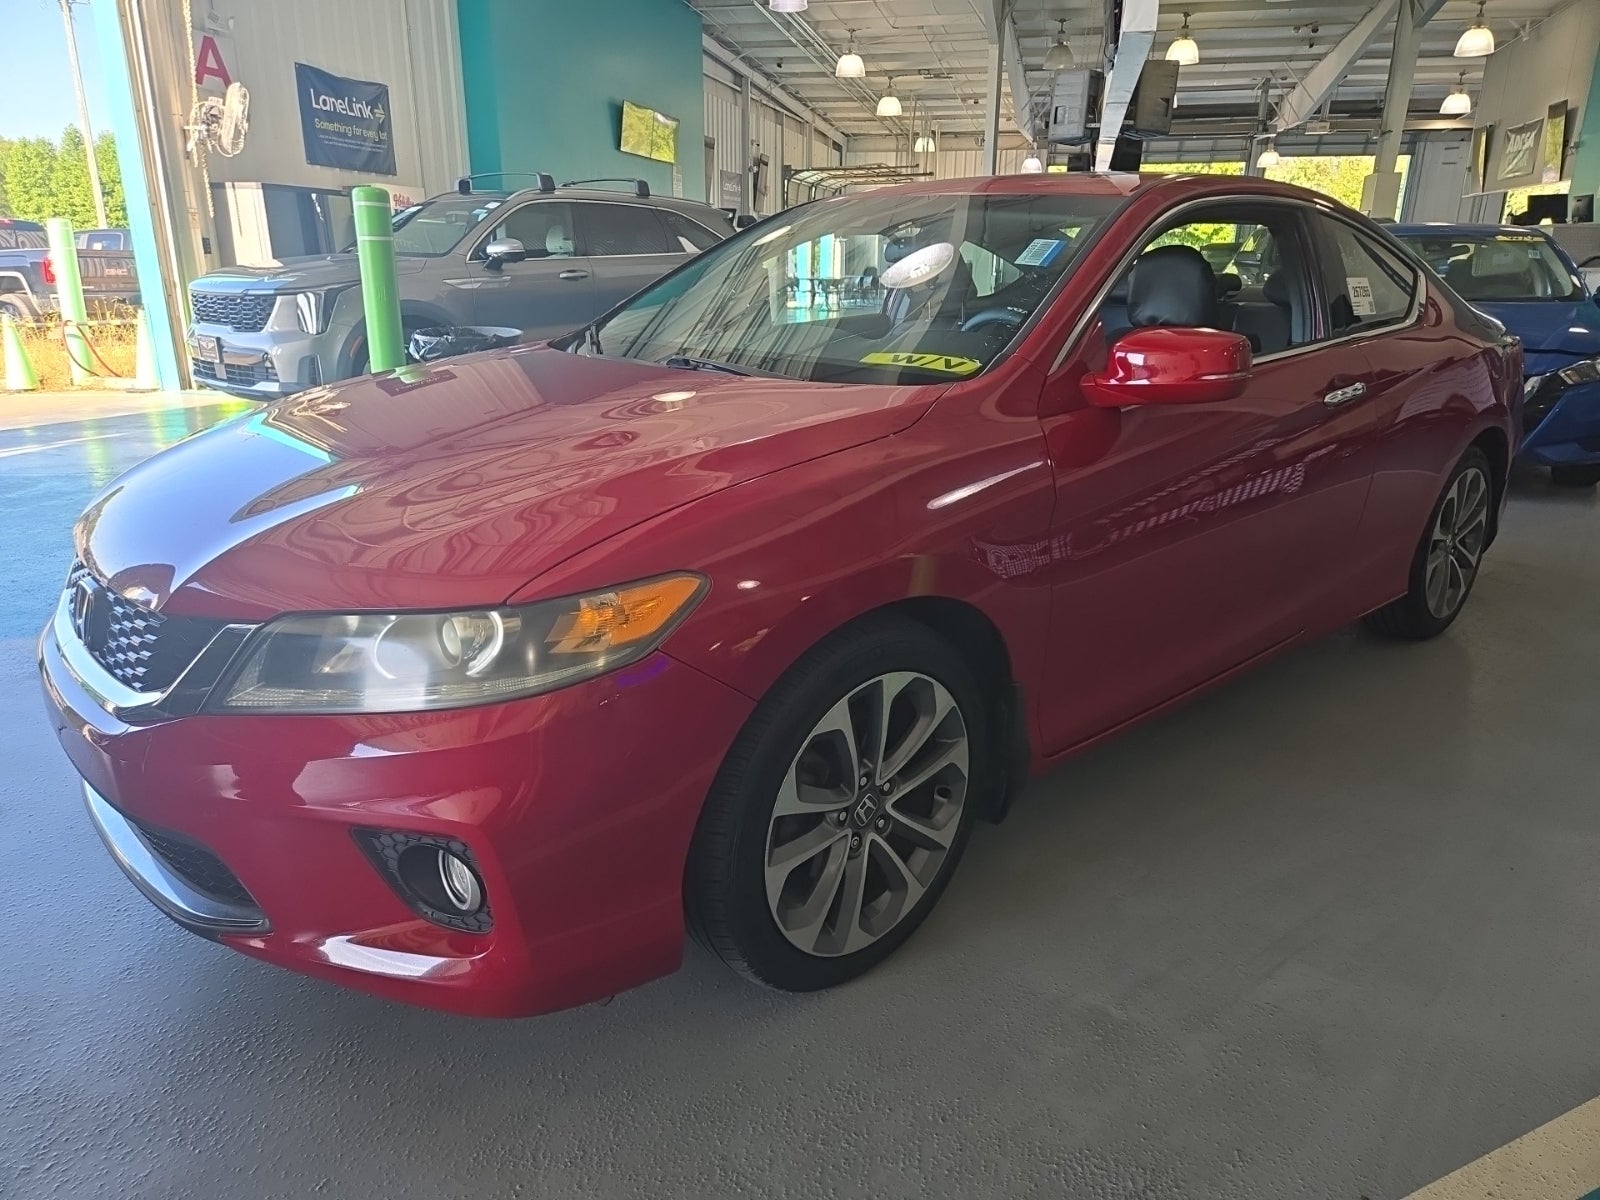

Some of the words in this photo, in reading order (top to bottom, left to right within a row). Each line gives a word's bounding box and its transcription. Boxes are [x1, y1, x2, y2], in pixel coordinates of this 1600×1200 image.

[195, 35, 232, 89] A
[310, 88, 374, 120] LaneLink
[314, 118, 352, 136] Something
[353, 125, 363, 136] for
[362, 130, 379, 142] every
[105, 268, 128, 276] GMC
